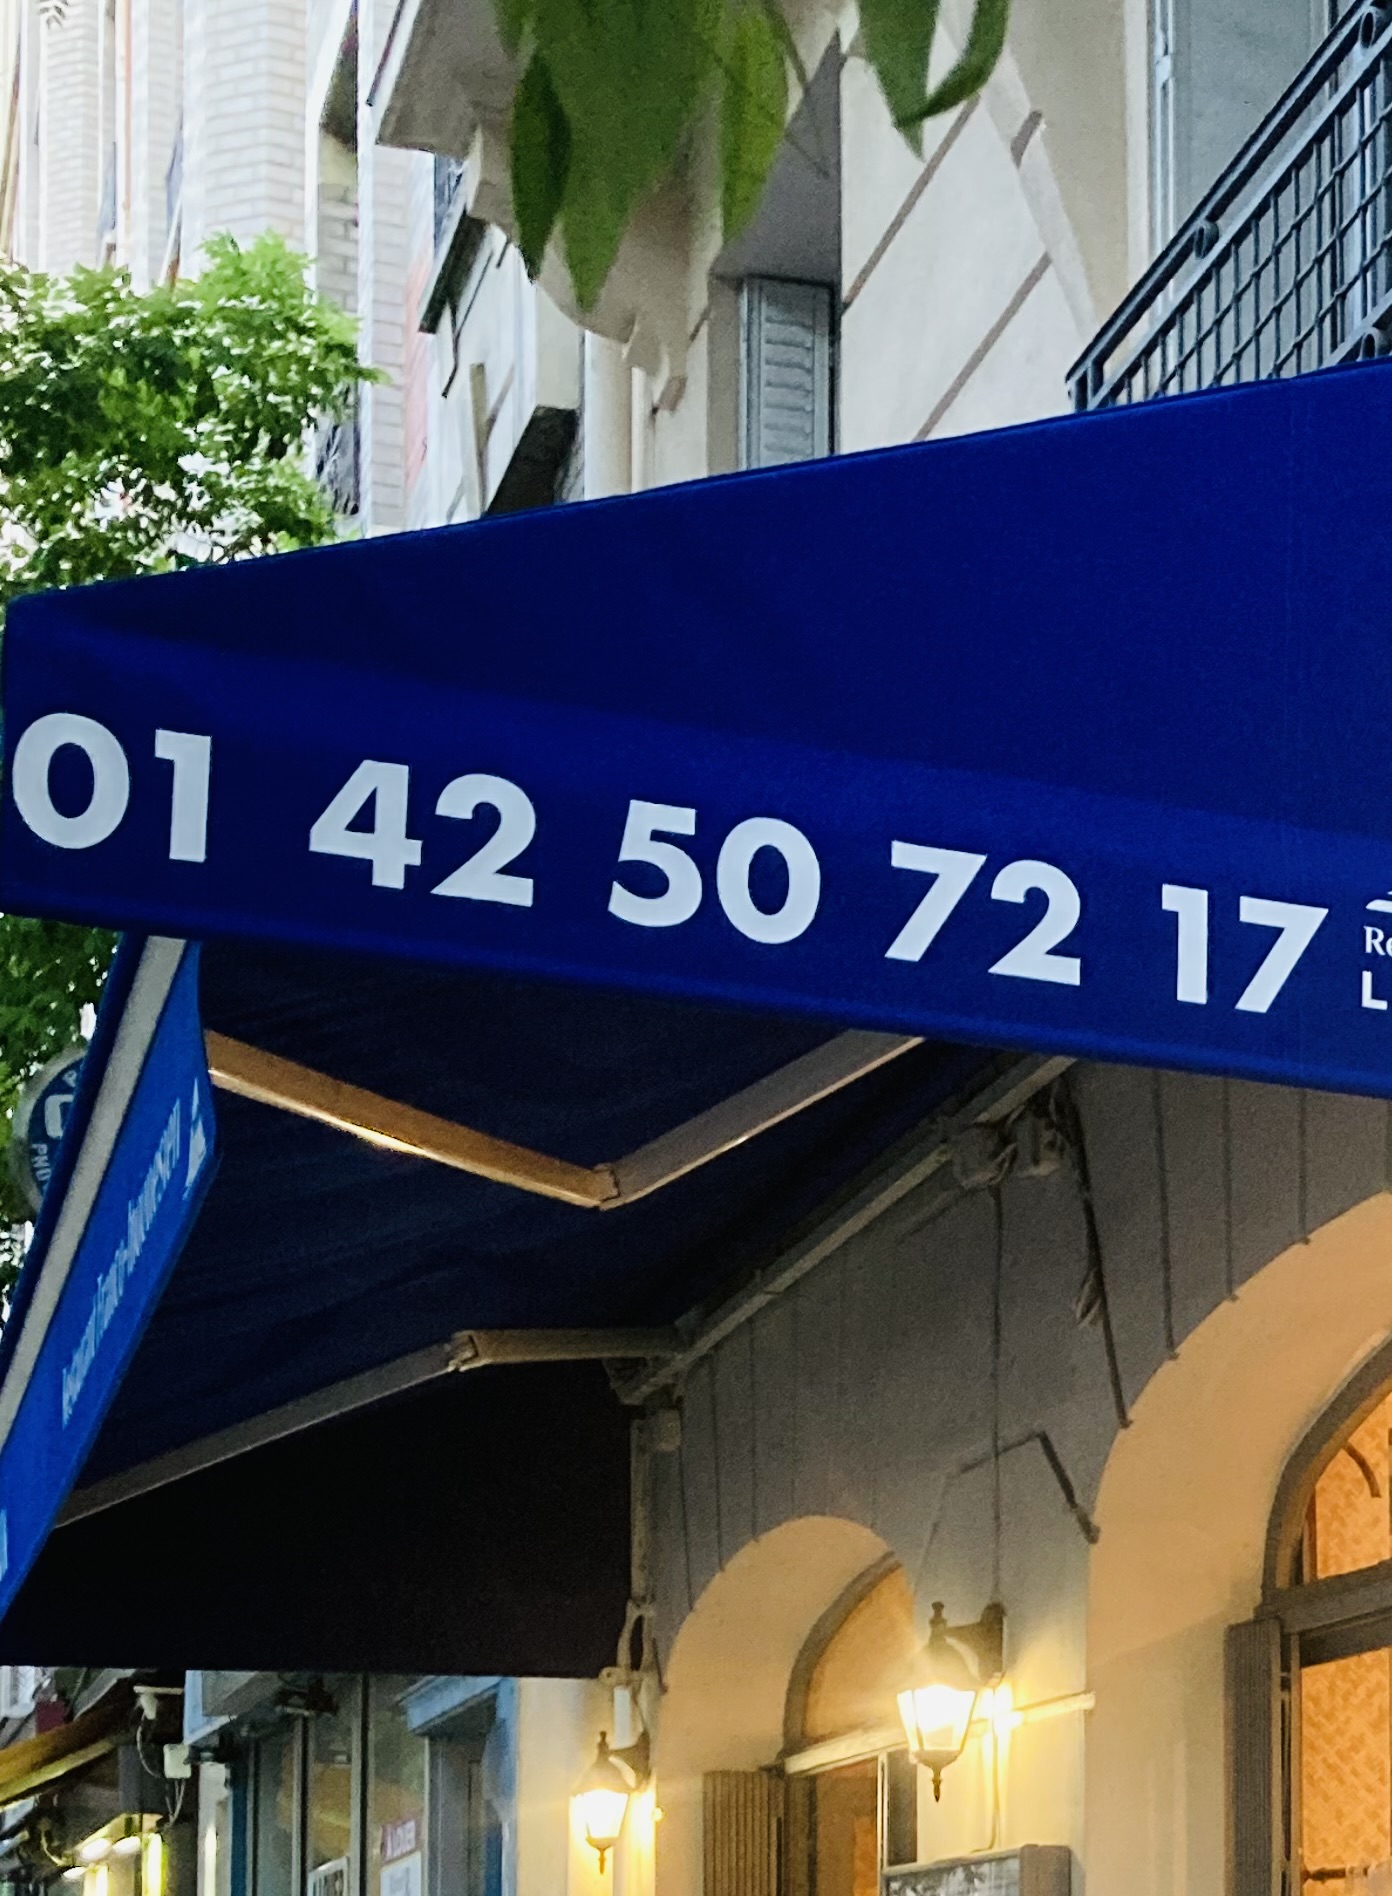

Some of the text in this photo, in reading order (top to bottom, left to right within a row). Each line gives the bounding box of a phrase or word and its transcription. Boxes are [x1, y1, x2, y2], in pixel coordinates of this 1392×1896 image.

[12, 712, 1329, 1014] 01 42 50 72 17
